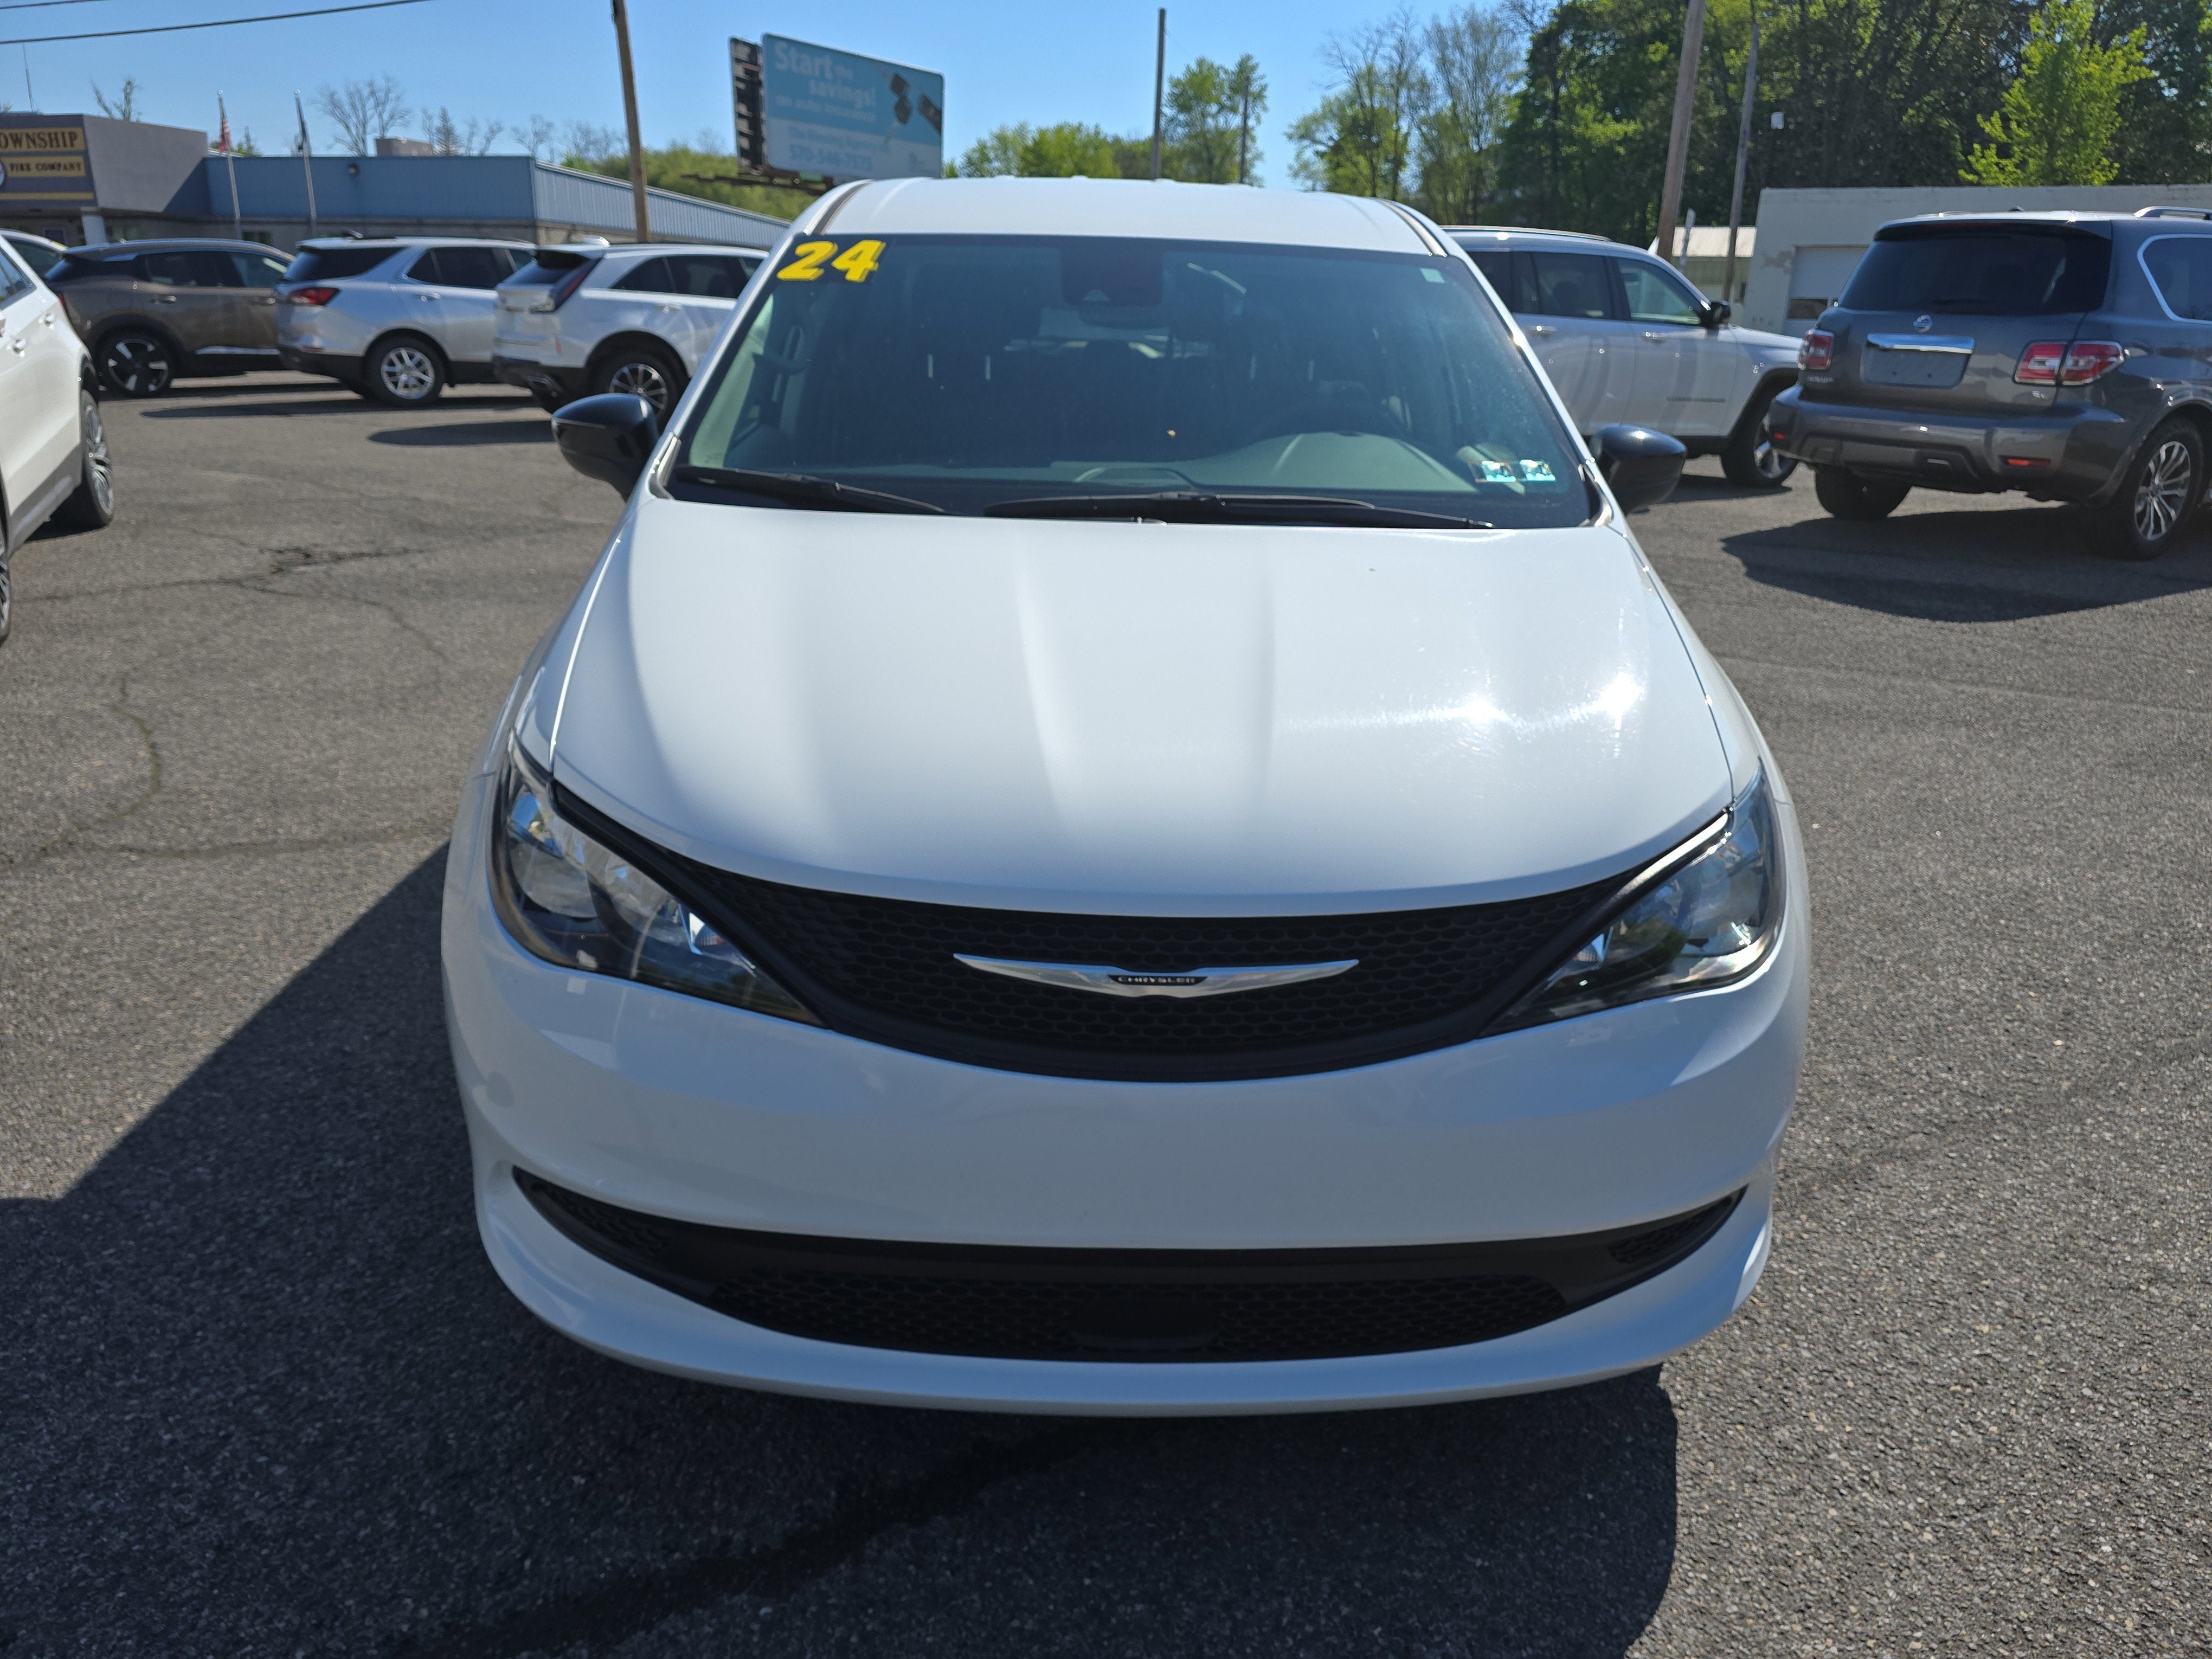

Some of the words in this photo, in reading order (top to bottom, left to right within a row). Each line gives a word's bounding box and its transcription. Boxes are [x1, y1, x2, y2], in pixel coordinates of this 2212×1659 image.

[775, 41, 832, 80] Start
[35, 162, 82, 172] COMPANY
[777, 240, 886, 282] 24
